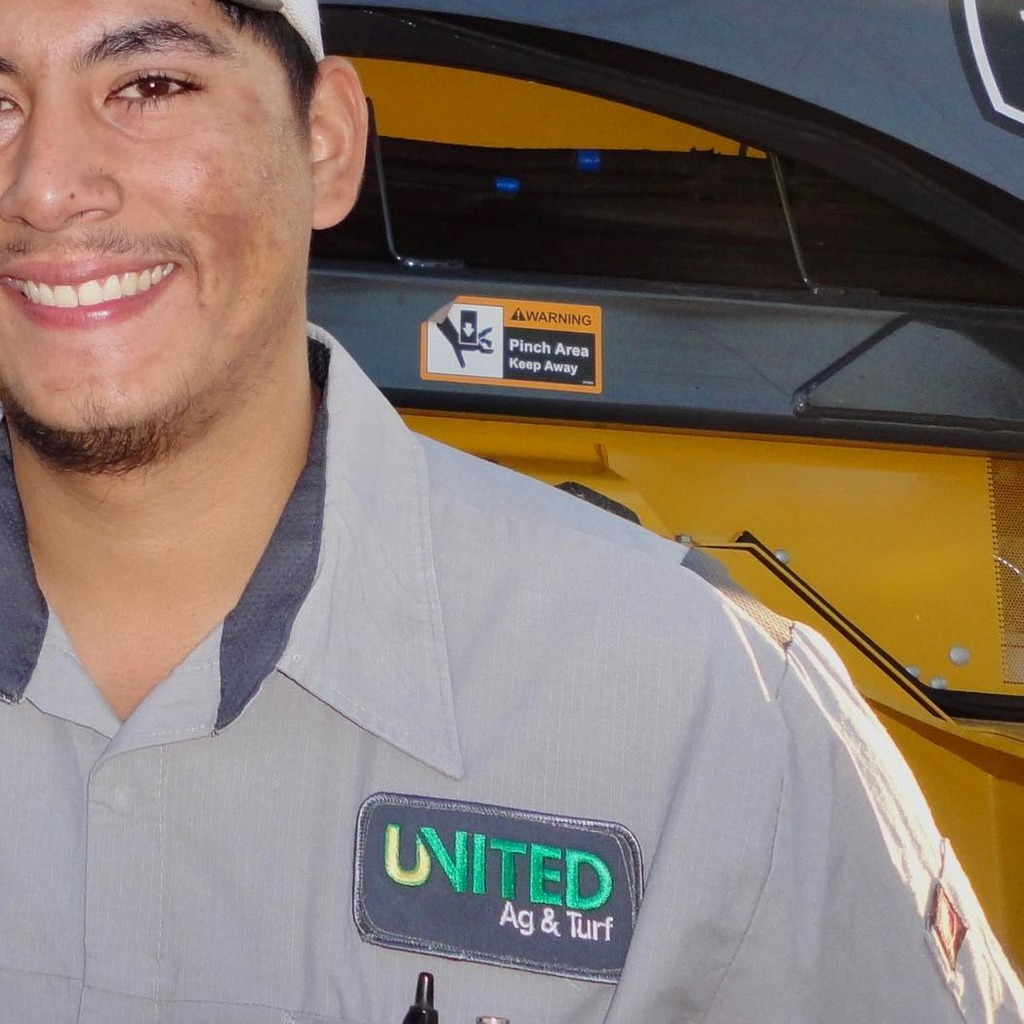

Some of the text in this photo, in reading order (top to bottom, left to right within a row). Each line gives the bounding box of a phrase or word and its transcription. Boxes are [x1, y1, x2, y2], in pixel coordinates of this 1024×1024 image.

[526, 311, 592, 326] WARNING
[509, 338, 589, 358] Pinch Area
[509, 357, 578, 376] Keep Away
[384, 824, 614, 910] UNITED
[499, 901, 614, 942] Ag & Turf
